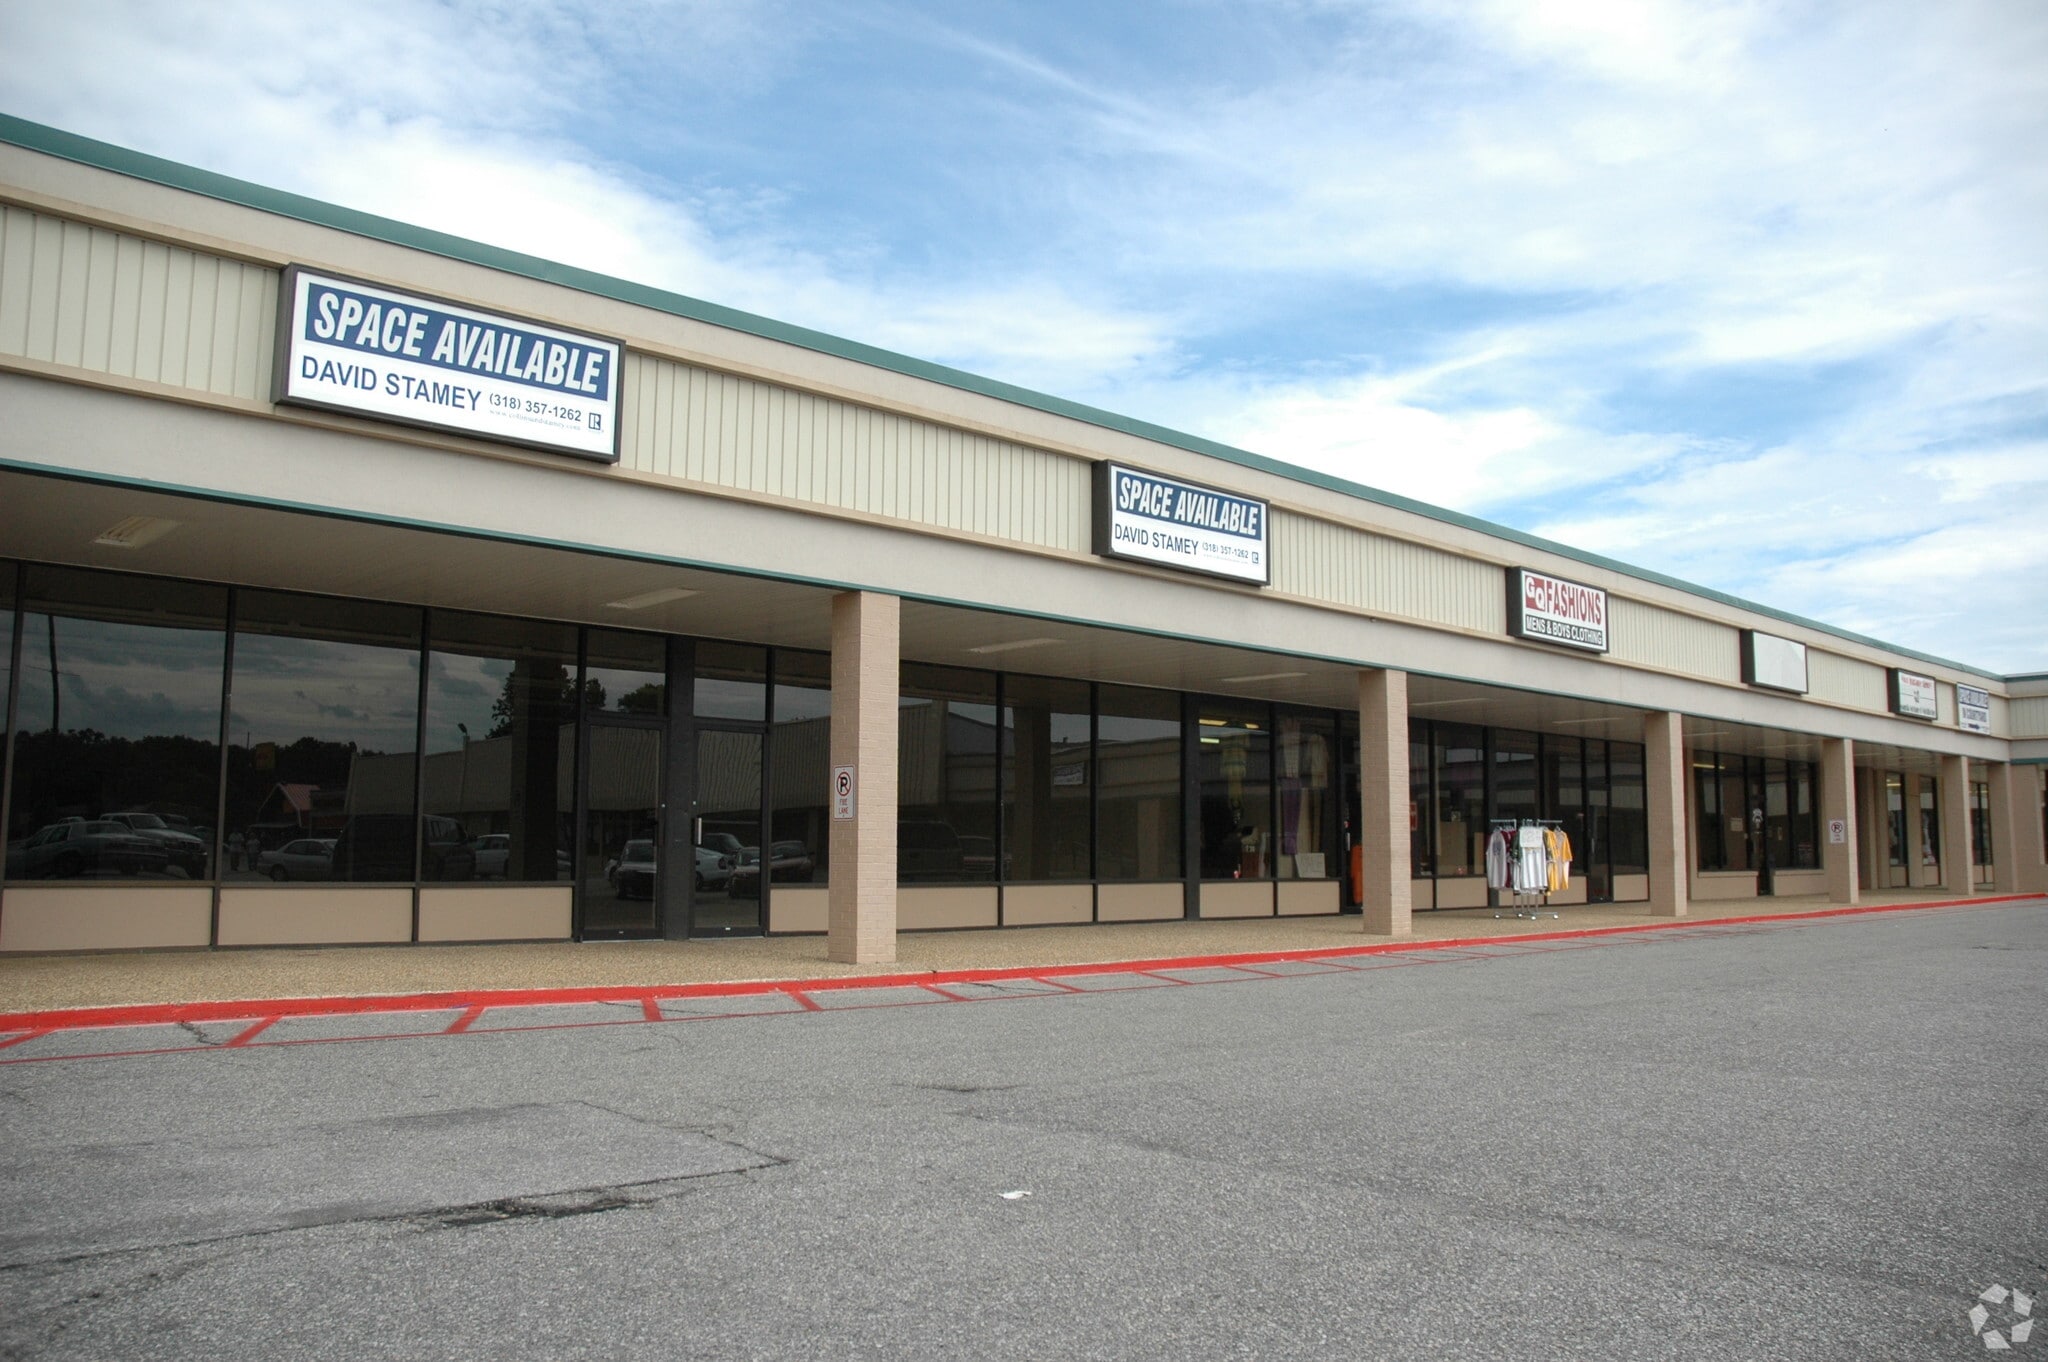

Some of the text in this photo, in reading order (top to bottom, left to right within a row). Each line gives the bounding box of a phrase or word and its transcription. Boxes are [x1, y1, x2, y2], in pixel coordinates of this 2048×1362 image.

[314, 292, 604, 394] SPACE AVAILABLE
[302, 355, 482, 412] DAVID STAMEY
[489, 392, 582, 422] (318) 357-1262
[1119, 477, 1258, 536] SPACE AVAILABLE
[1115, 523, 1199, 555] DAVID STAMEY
[1202, 541, 1219, 553] (318)
[1220, 545, 1249, 559] 357-1262
[1546, 580, 1602, 625] FASHIONS
[1526, 616, 1602, 645] MENS & BOYS CLOTHING
